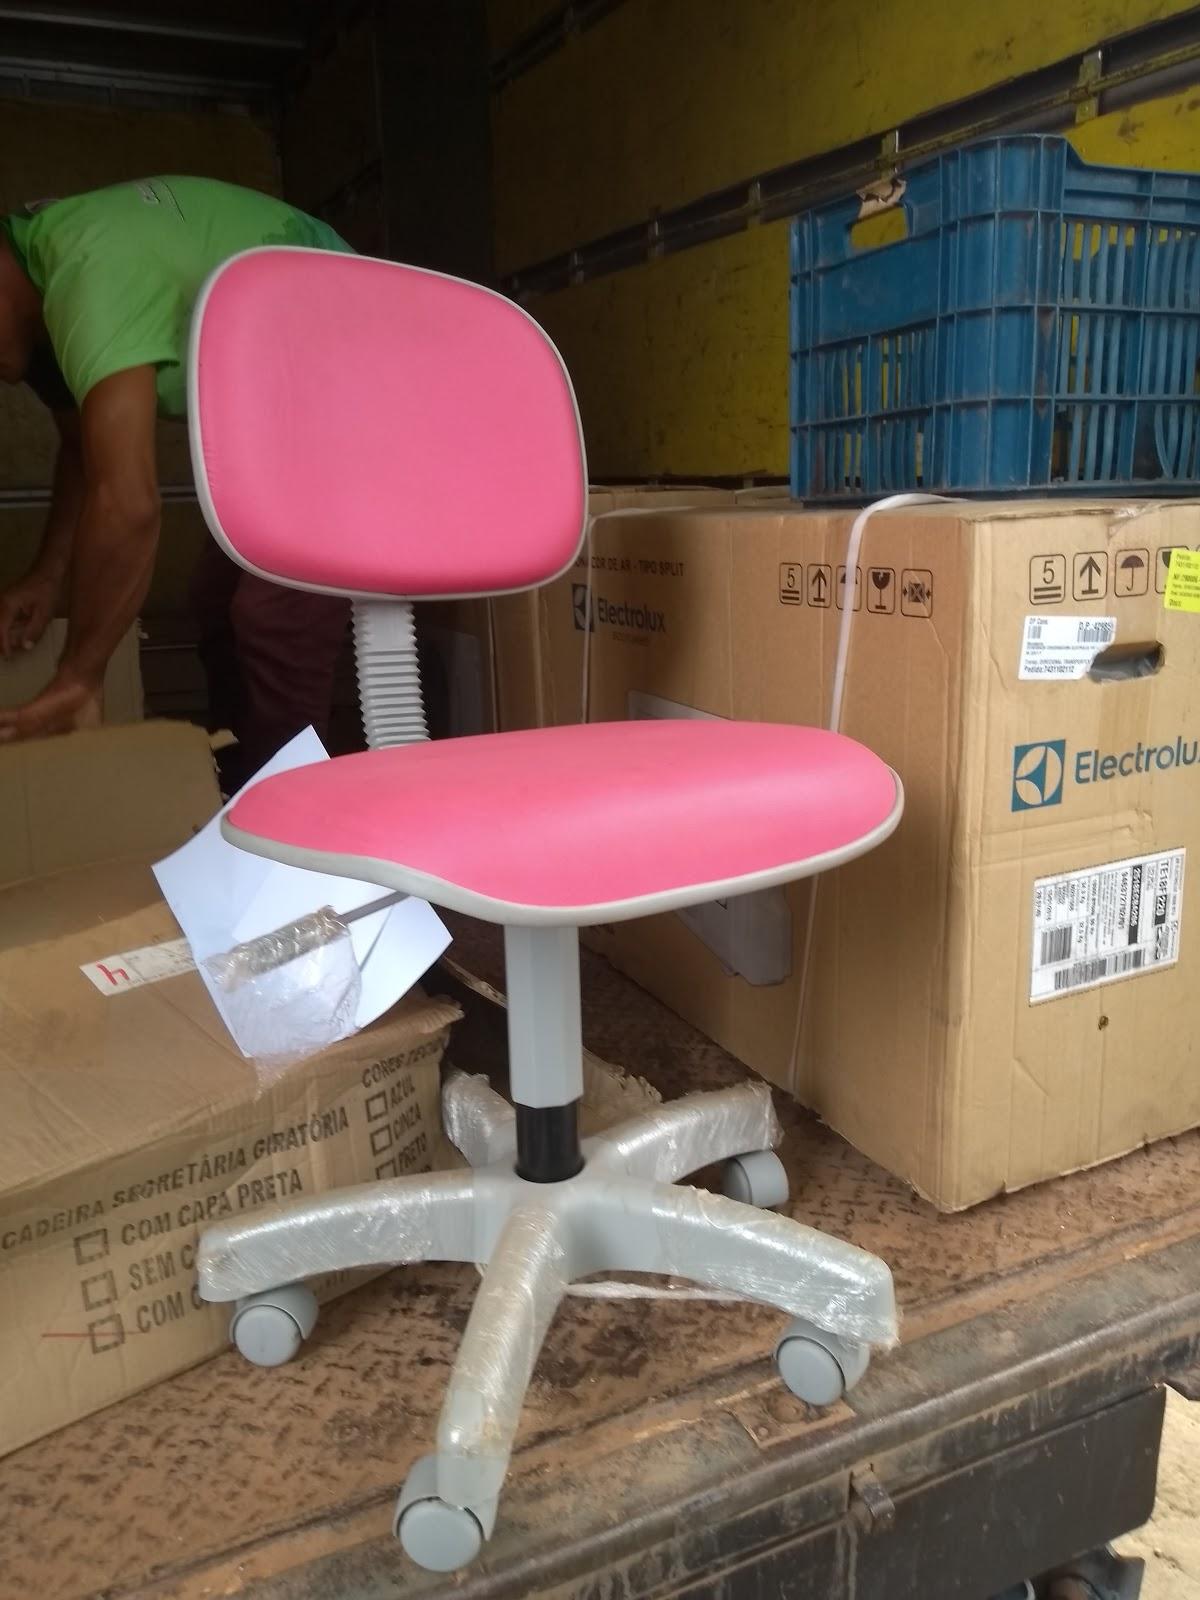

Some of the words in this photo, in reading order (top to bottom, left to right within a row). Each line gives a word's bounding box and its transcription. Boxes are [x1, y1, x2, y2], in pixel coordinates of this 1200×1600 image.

[660, 560, 684, 577] SPLIT
[1042, 560, 1055, 585] 5
[597, 597, 667, 634] Electrolux
[1074, 735, 1200, 785] Electrolu
[390, 1075, 416, 1108] AZUL
[393, 1102, 422, 1140] CINZA
[398, 1131, 427, 1172] PRETO
[2, 1200, 105, 1250] CADEIRA
[121, 1212, 171, 1246] COM
[177, 1191, 233, 1228] CAPA
[237, 1168, 304, 1209] PRETA
[128, 1251, 177, 1291] SEM
[137, 1291, 185, 1333] COM
